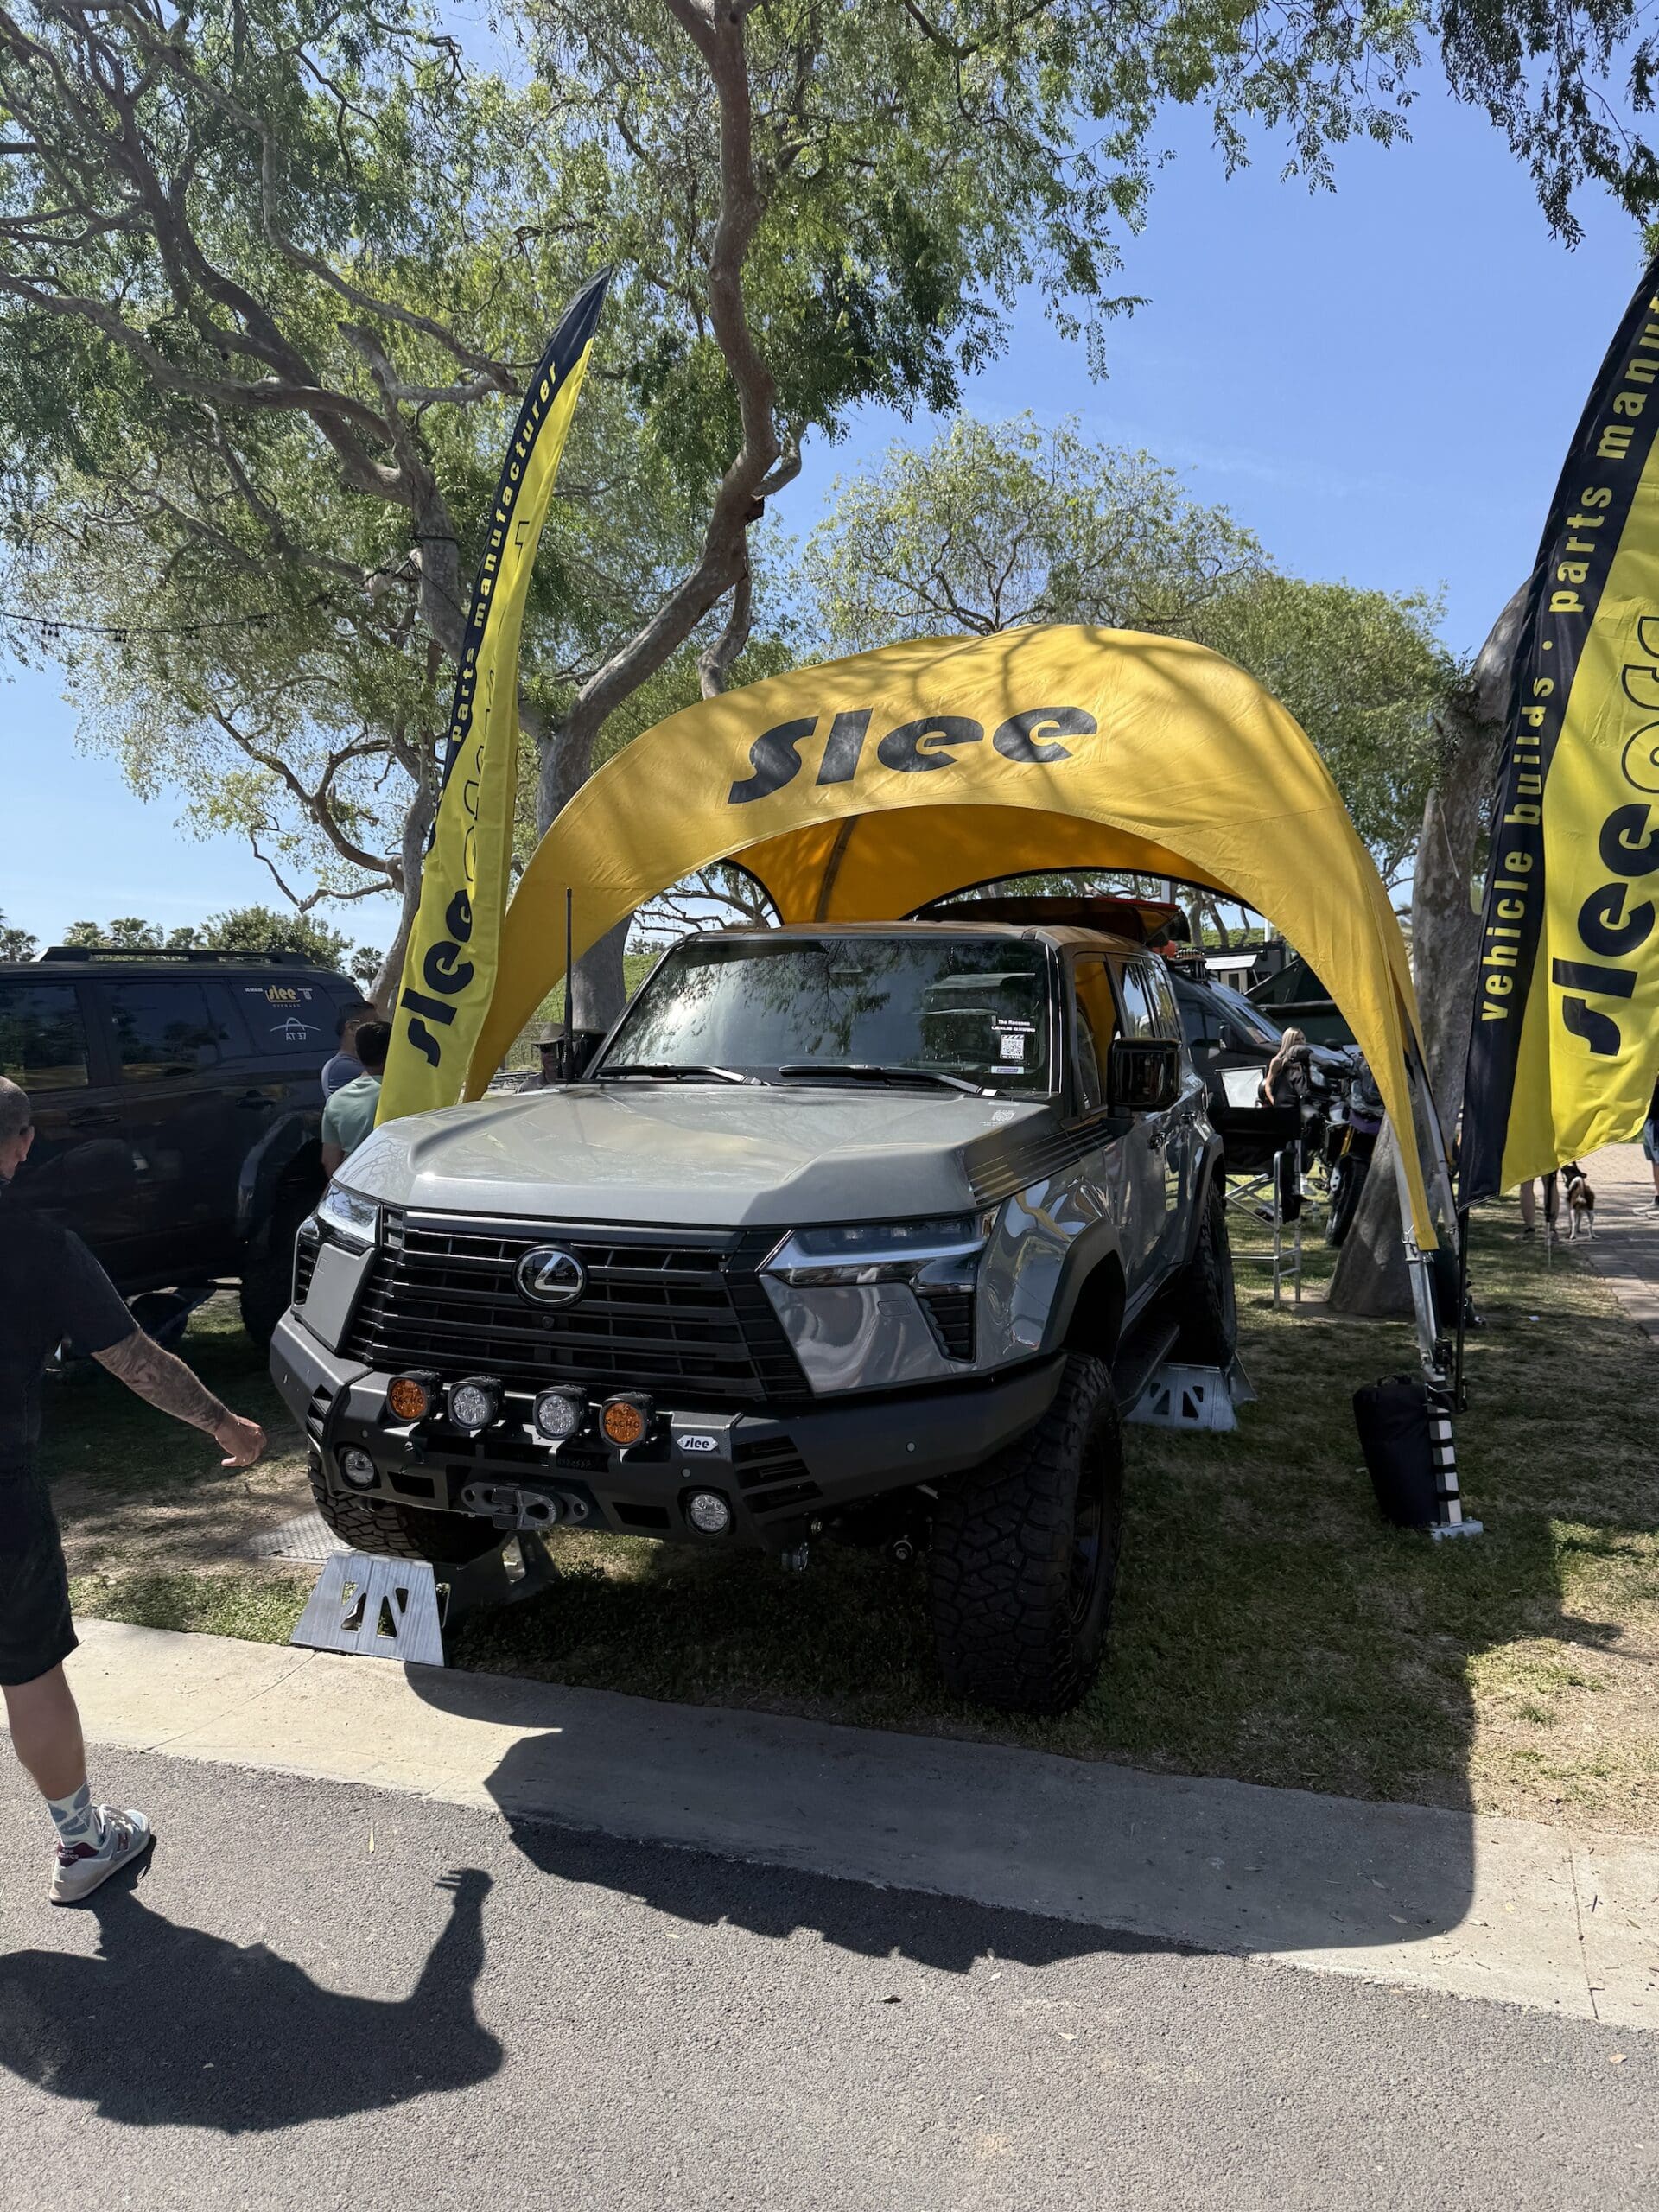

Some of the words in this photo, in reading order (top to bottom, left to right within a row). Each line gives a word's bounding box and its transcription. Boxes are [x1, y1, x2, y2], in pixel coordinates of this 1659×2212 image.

[452, 647, 474, 742] parts
[474, 360, 558, 628] manufacturer
[1548, 486, 1613, 613] parts
[727, 706, 1097, 804] slee
[1503, 677, 1554, 826] builds
[269, 985, 296, 1000] slee
[1481, 850, 1534, 1022] vehicle
[1552, 803, 1659, 1057] slee
[286, 1032, 296, 1041] AT
[297, 1032, 307, 1040] 37
[683, 1437, 709, 1449] slee
